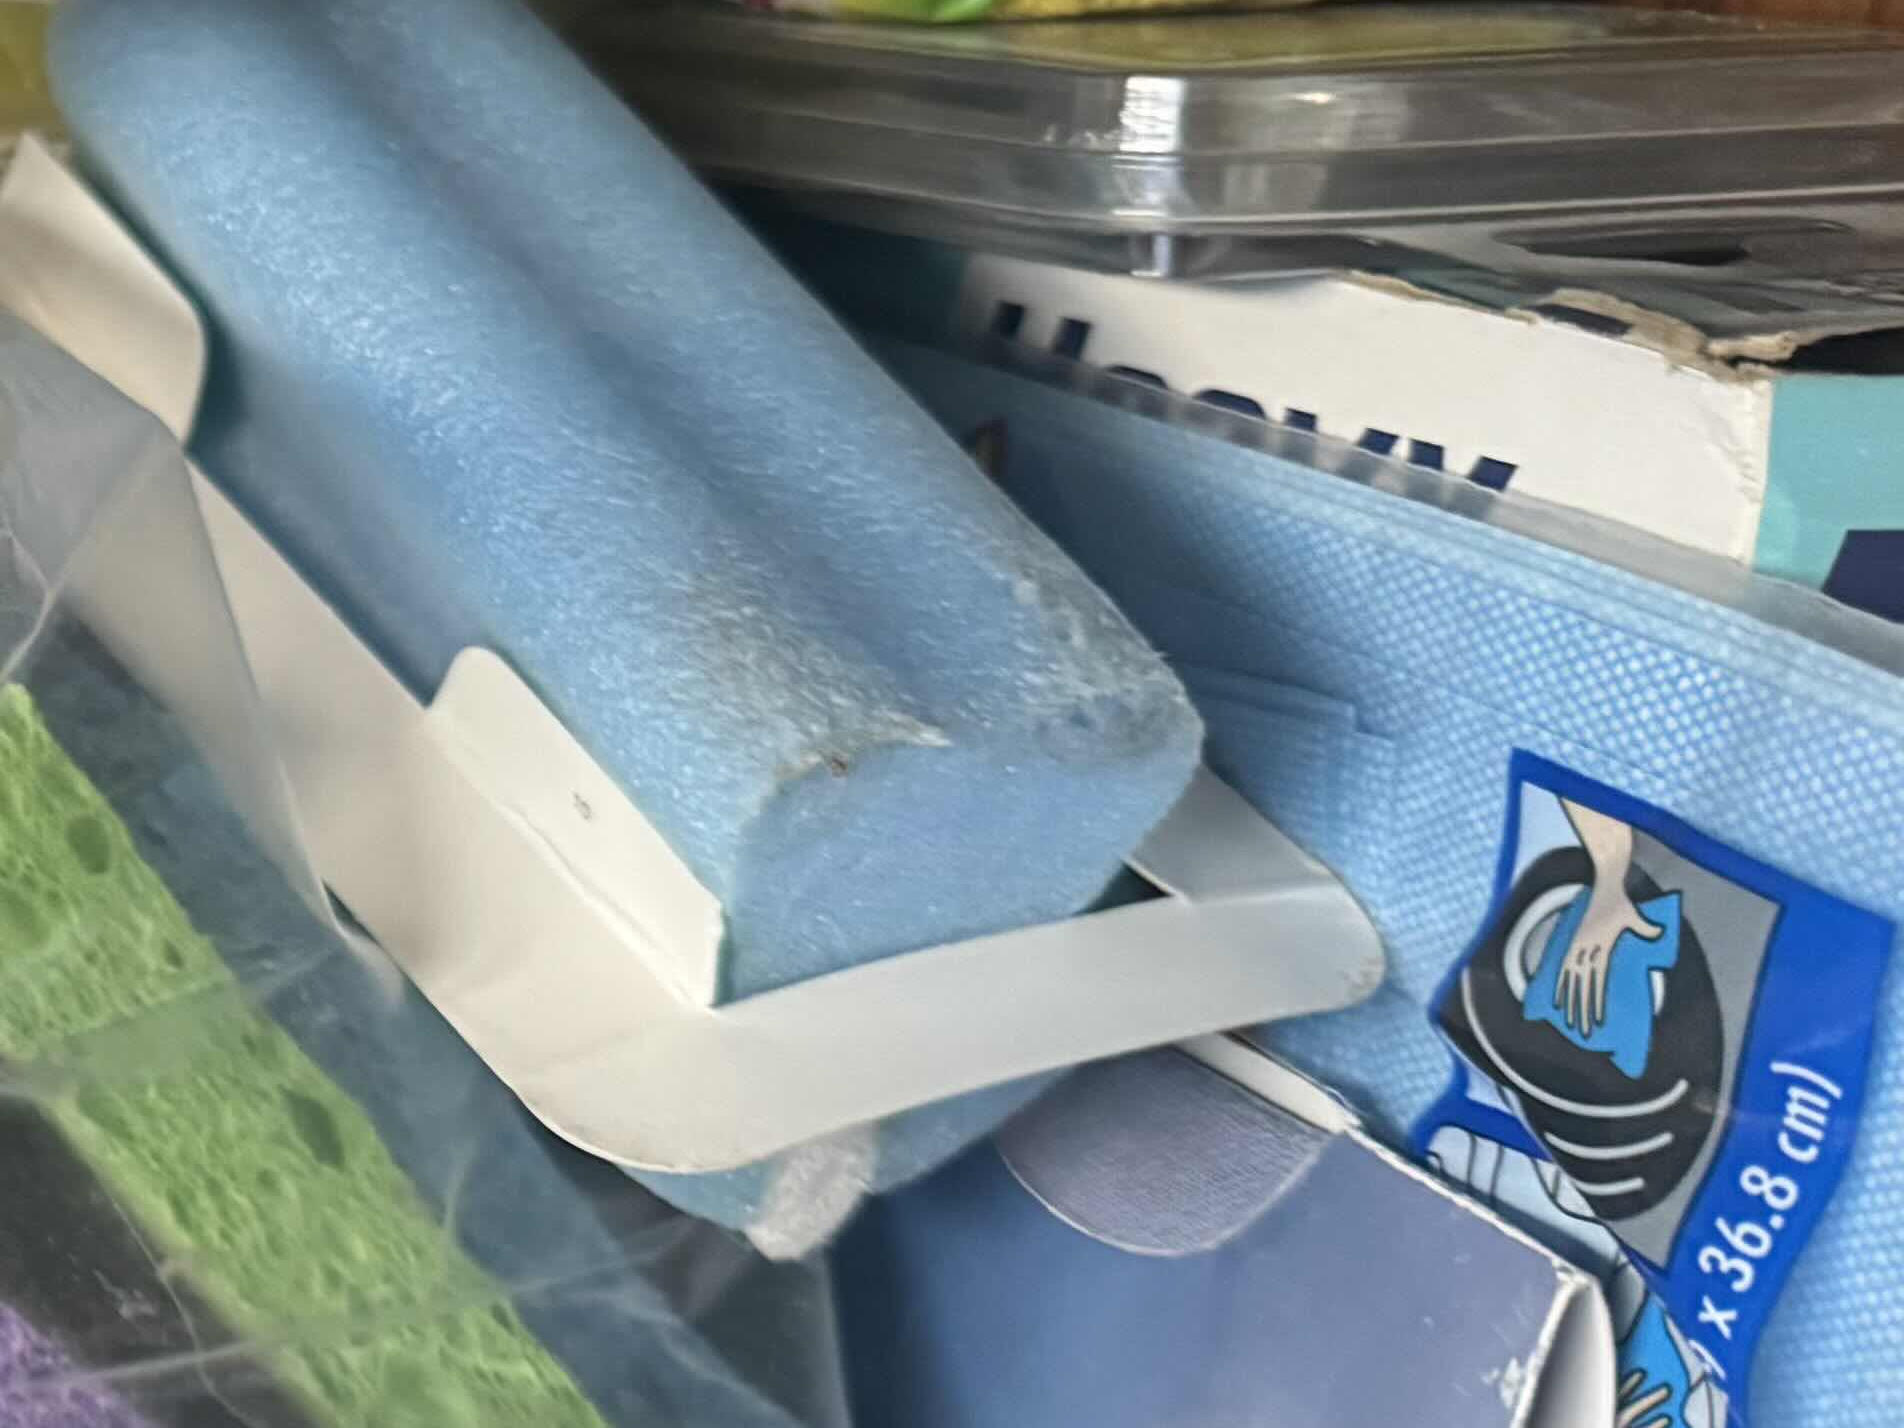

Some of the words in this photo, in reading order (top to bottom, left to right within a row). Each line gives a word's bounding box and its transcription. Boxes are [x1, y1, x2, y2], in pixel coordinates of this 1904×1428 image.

[1773, 1054, 1840, 1164] cm)
[1698, 1160, 1801, 1294] 36.8
[1689, 1292, 1739, 1337] x
